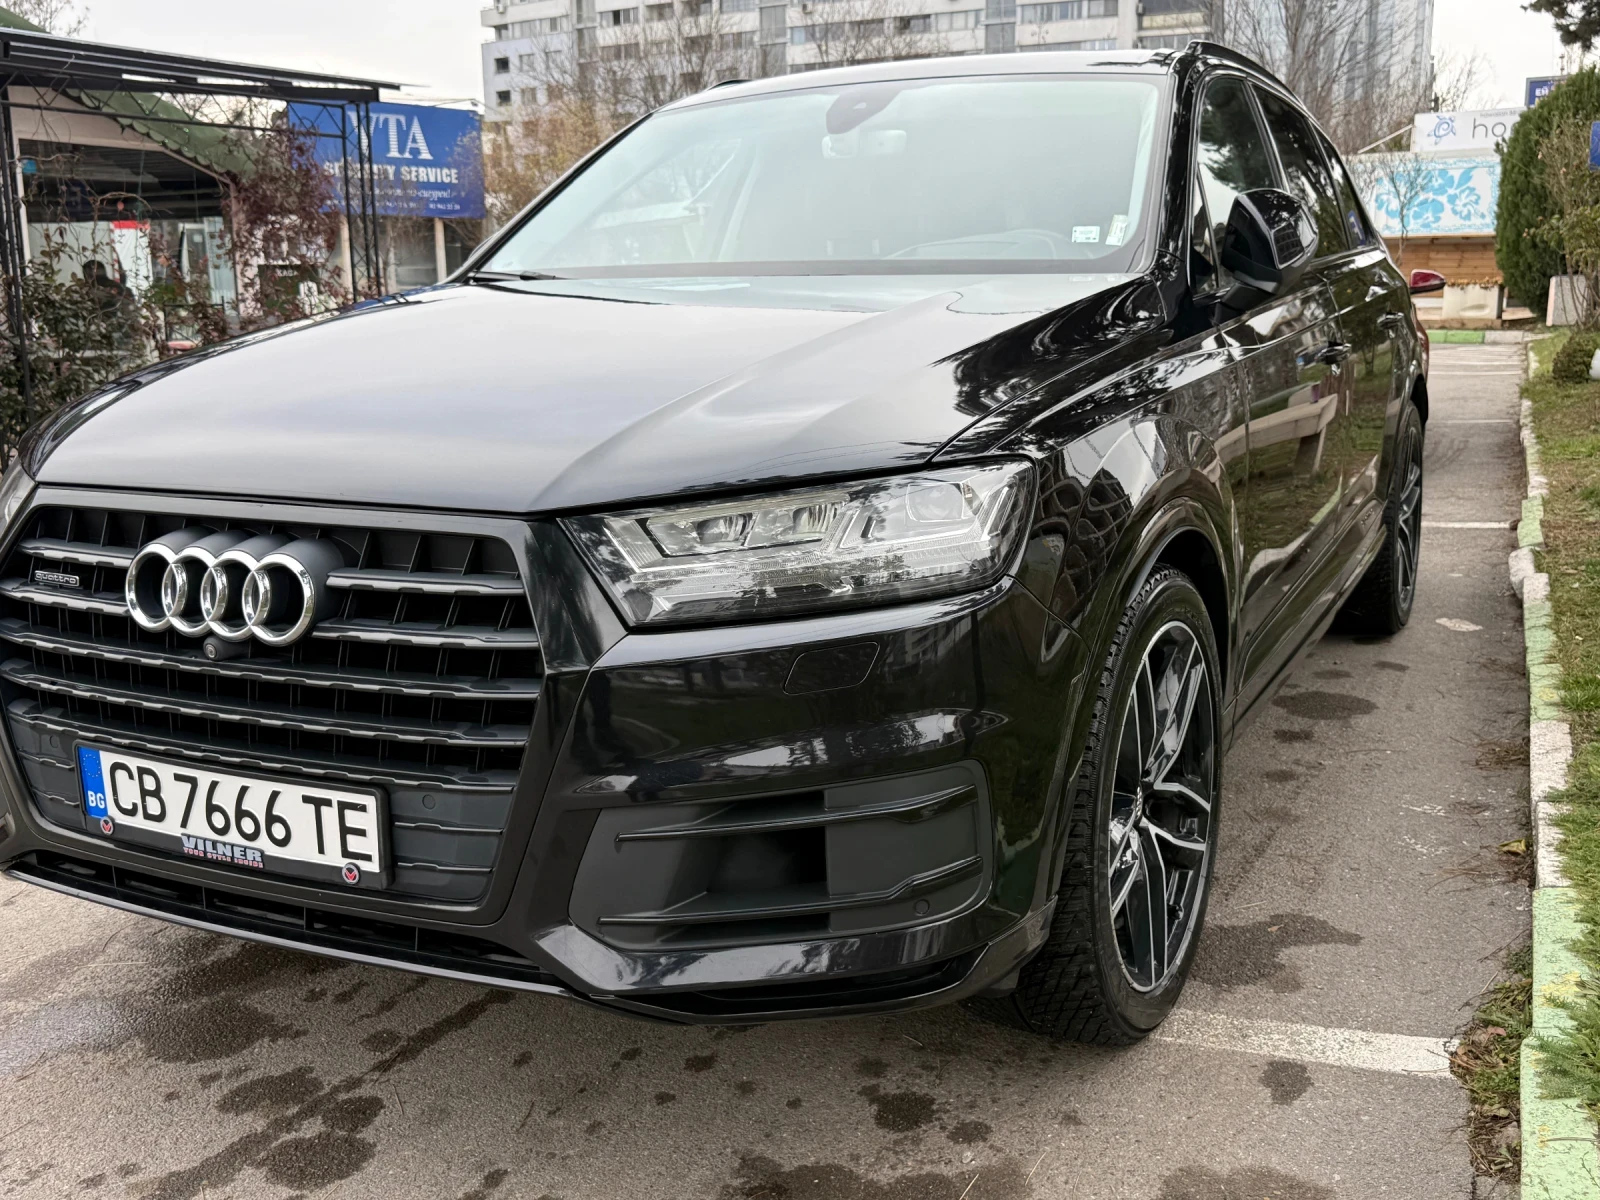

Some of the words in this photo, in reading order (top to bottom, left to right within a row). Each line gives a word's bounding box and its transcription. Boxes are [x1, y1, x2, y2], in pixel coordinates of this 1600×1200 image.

[348, 111, 434, 160] VTA
[401, 165, 459, 184] SERVICE
[35, 572, 76, 584] quattro
[87, 790, 106, 809] BG
[109, 761, 167, 823] CB
[173, 773, 292, 847] 7666
[301, 794, 373, 862] TE
[181, 835, 262, 861] VILNER
